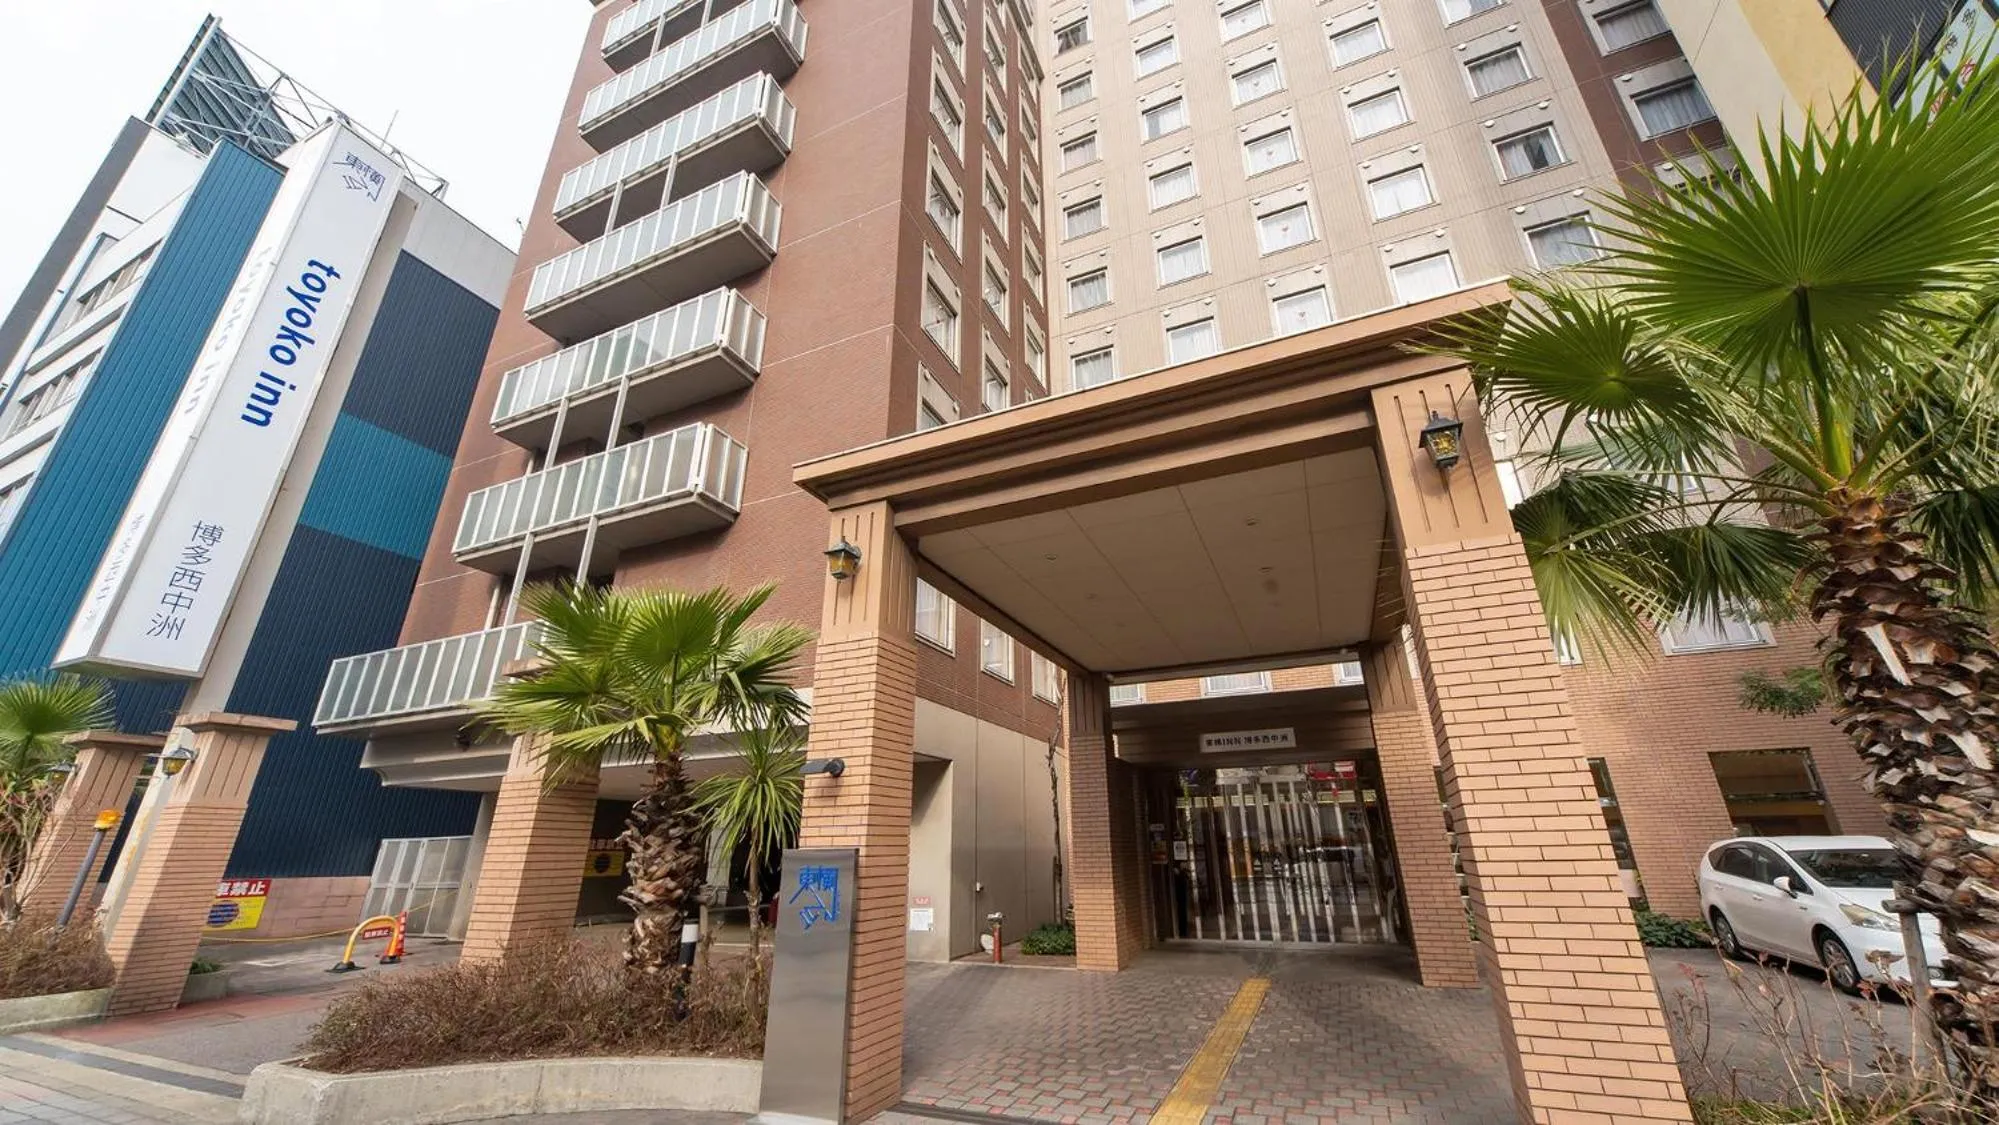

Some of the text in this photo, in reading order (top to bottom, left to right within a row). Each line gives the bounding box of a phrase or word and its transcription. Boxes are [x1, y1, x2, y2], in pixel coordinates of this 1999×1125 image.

[240, 259, 341, 428] toyoko inn
[145, 519, 225, 641] 博多西中洲
